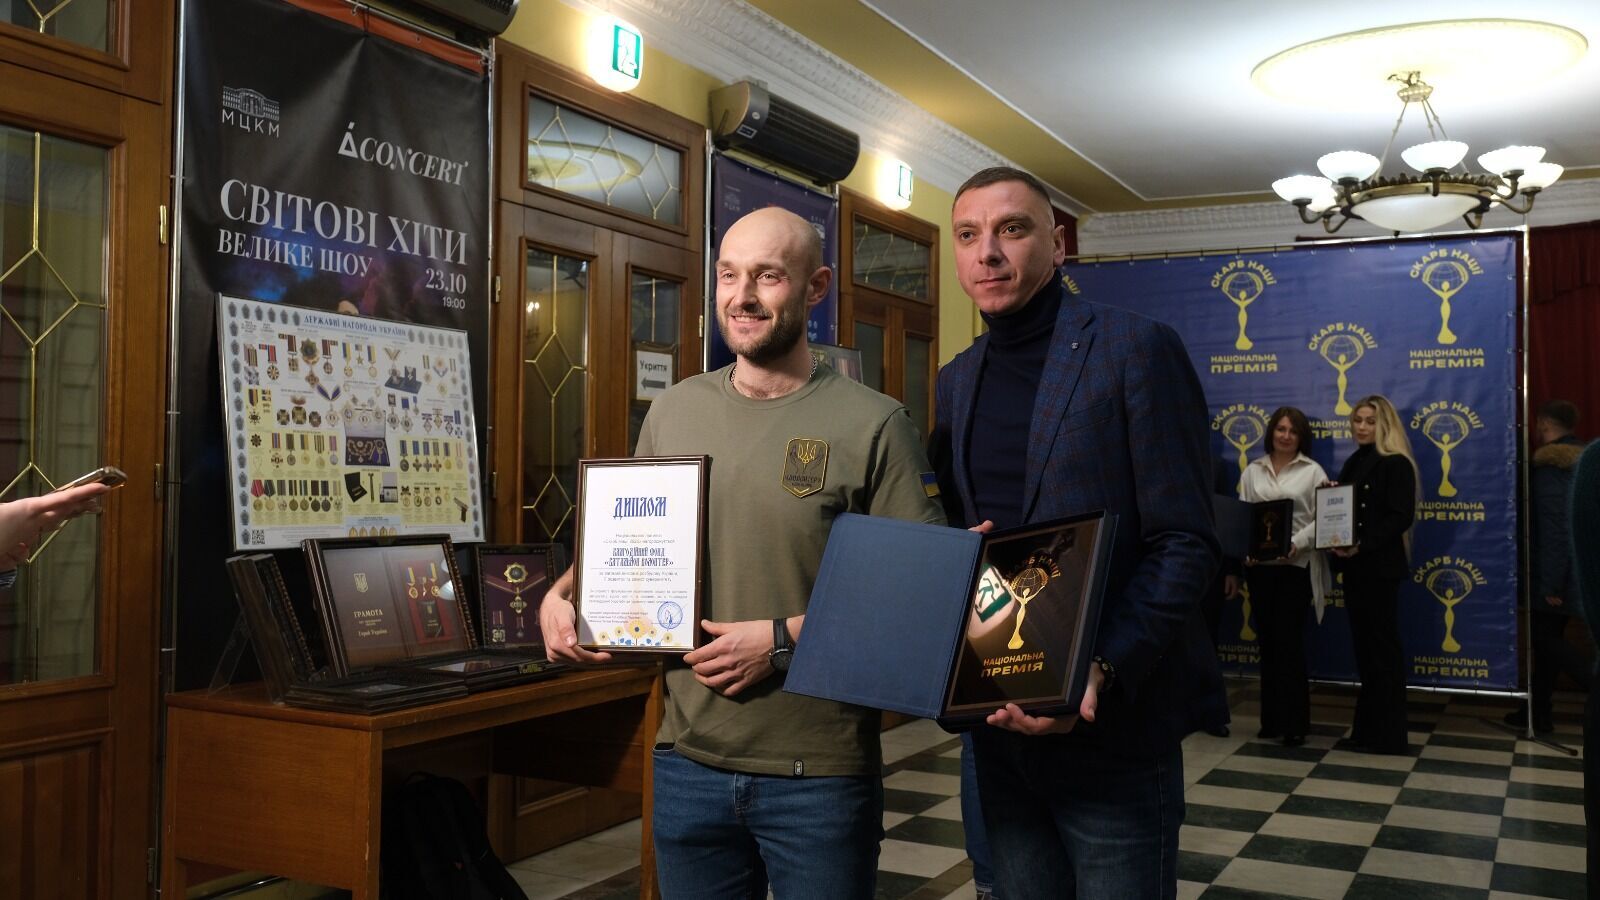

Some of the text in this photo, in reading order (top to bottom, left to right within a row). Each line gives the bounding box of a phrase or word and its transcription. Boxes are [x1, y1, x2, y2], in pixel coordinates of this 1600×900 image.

[222, 109, 280, 138] МЦКМ
[220, 178, 467, 265] СВІТОВІ ХІТИ
[217, 228, 373, 278] ВЕЛИКЕ ШОУ
[1410, 248, 1484, 278] СКАРБ НАЦІЇ
[425, 268, 467, 295] 23.10
[1211, 260, 1277, 288] СКАРБ НАЦІЇ
[1062, 274, 1081, 294] АЦІЇ
[442, 296, 466, 310] 19:00
[1309, 322, 1344, 351] СКАРБ
[1211, 354, 1277, 364] НАЦІОНАЛЬНА
[1410, 348, 1484, 358] НАЦІОНАЛЬНА
[640, 360, 668, 372] Укриття
[1211, 363, 1278, 373] ПРЕМІЯ
[1410, 358, 1484, 369] ПРЕМІЯ
[1211, 404, 1271, 430] СКАРБ НАЦ
[1410, 401, 1448, 429] СКАРБ
[1309, 420, 1351, 429] НАЦІОНА
[613, 496, 667, 519] ДИПЛОМ
[1417, 502, 1485, 510] АЦІОНАЛЬНА
[1414, 556, 1451, 583] СКАРБ
[354, 608, 383, 618] ГРАМОТА
[983, 651, 1045, 666] НАЦІОНАЛЬНА
[1414, 656, 1488, 667] НАЦІОНАЛЬНА
[981, 661, 1044, 678] ПРЕМІЯ
[1414, 665, 1489, 678] ПРЕМІЯ
